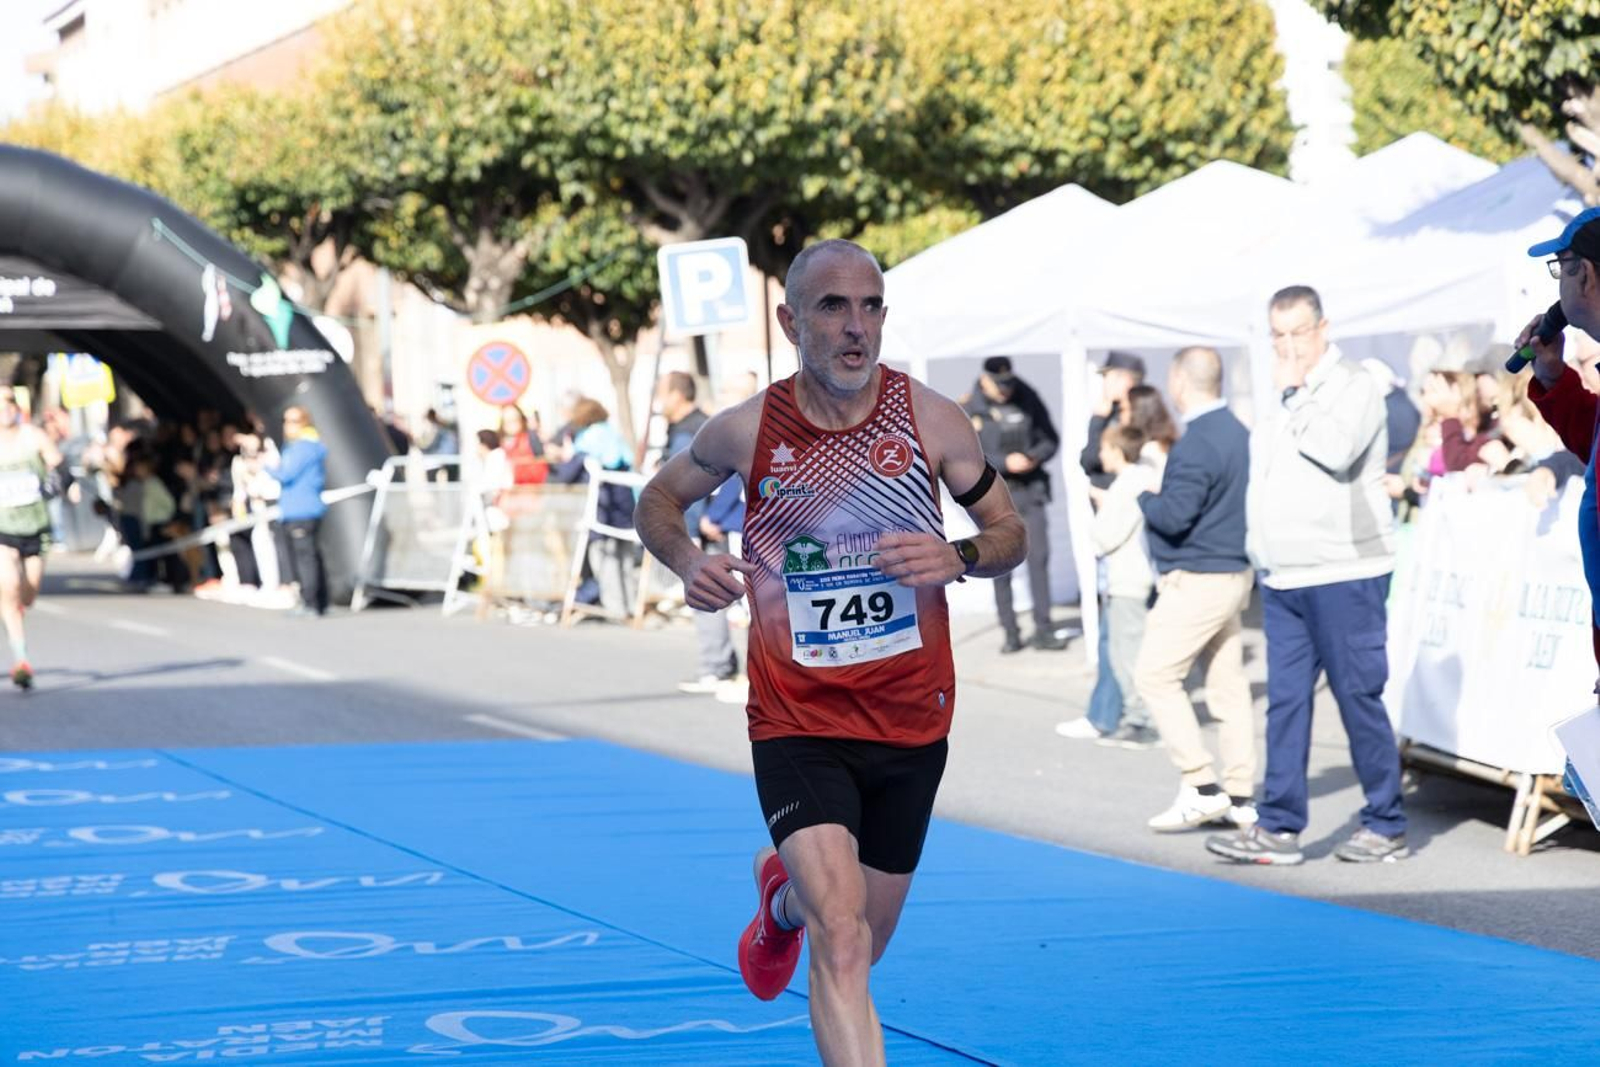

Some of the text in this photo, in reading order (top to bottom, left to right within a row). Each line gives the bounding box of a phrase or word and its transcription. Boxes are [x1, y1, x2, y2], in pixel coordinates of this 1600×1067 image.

[677, 251, 732, 325] P
[770, 464, 797, 474] luanvi
[837, 531, 878, 554] FUNDA
[811, 591, 894, 630] 749
[828, 630, 861, 641] MANUEL
[864, 625, 885, 636] JUAN
[139, 1039, 384, 1062] MEDIA
